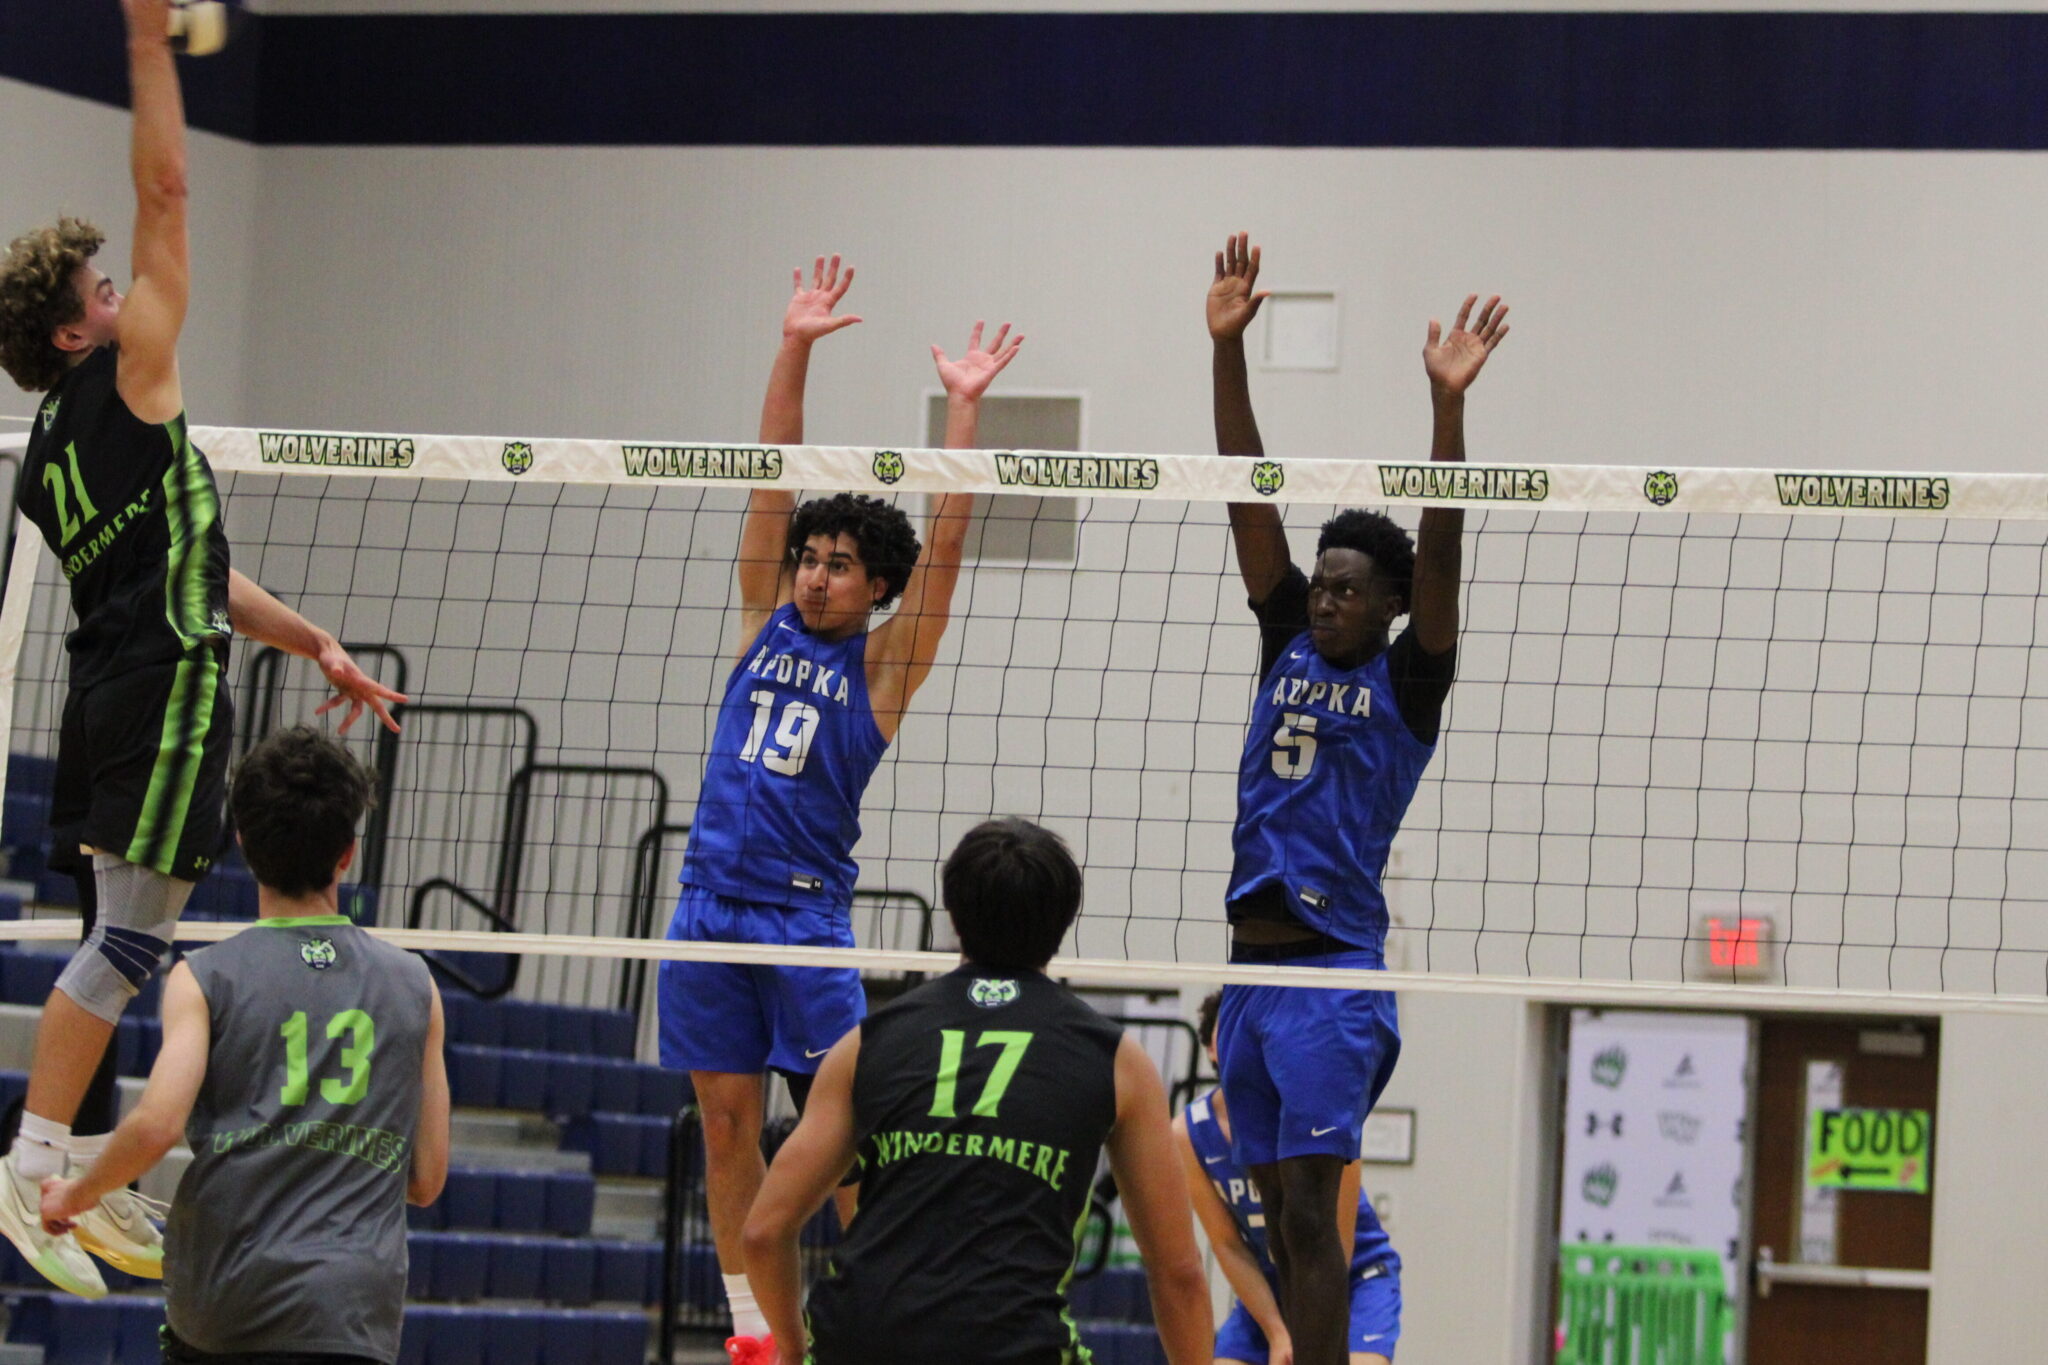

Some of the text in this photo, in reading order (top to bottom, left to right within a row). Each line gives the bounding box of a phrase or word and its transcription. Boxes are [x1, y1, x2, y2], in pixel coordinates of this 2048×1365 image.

[42, 440, 99, 548] 21
[259, 433, 1949, 509] WOLVERINES WOLVERINES WOLVERINES WOLVERINES WOLVERINES
[748, 645, 848, 707] APOPKA
[739, 690, 820, 777] 19
[1271, 712, 1318, 780] 5
[280, 1009, 375, 1106] 13
[927, 1029, 1034, 1118] 17
[871, 1131, 1070, 1192] WINDERMERE
[1819, 1110, 1922, 1156] FOOD
